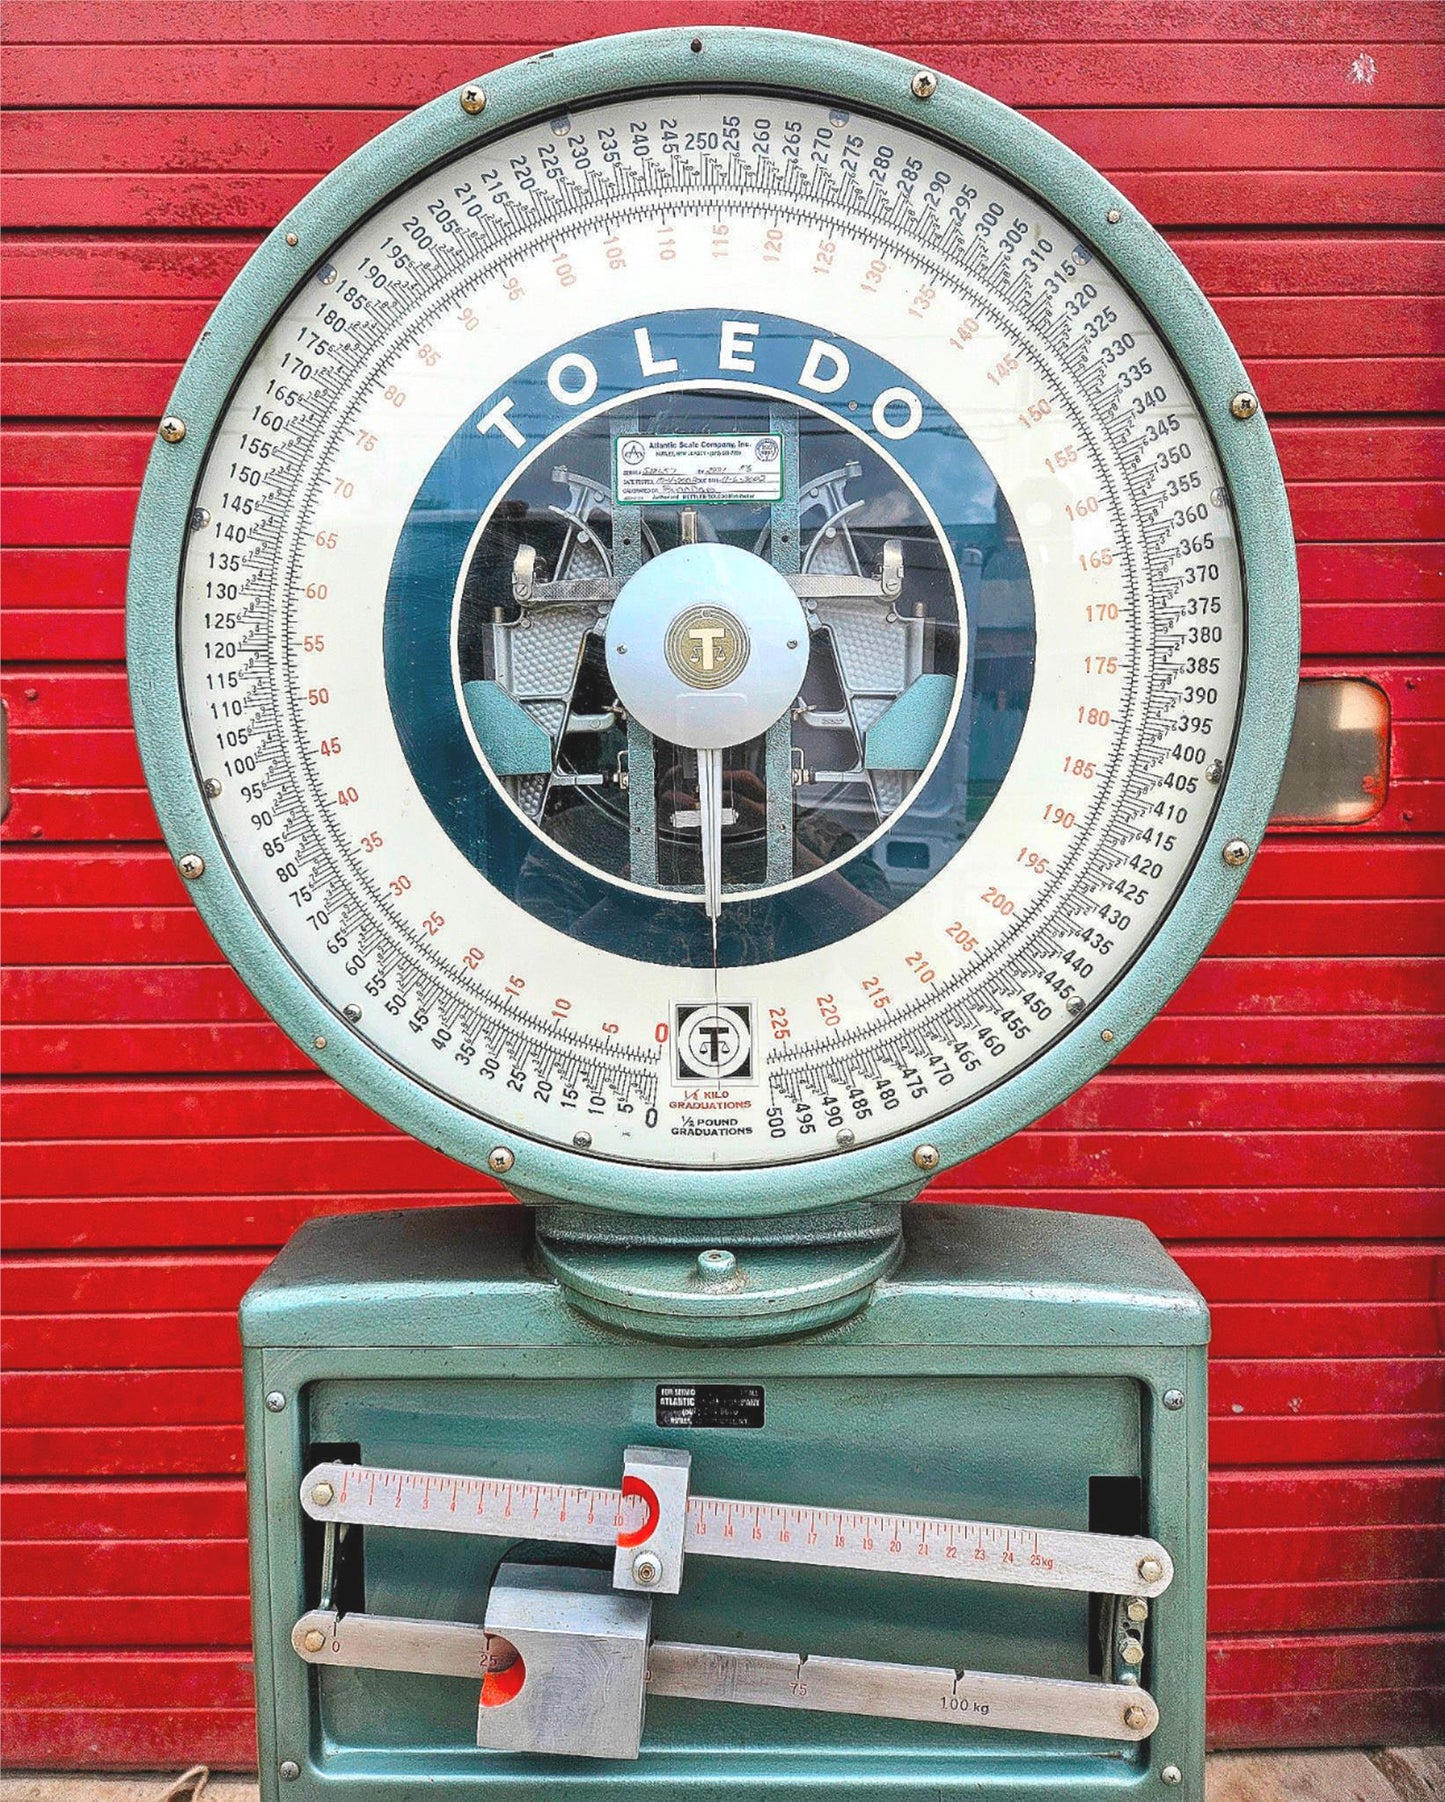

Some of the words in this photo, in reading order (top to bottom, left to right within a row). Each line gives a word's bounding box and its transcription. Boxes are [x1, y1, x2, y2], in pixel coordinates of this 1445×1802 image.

[598, 128, 621, 162] 235
[630, 122, 650, 156] 240
[684, 133, 718, 149] 250
[722, 116, 740, 151] 255
[752, 119, 771, 154] 260
[811, 128, 833, 164] 270
[568, 135, 591, 169] 230
[840, 135, 864, 172] 275
[869, 146, 894, 182] 280
[510, 155, 536, 190] 220
[481, 169, 510, 204] 215
[924, 171, 951, 207] 290
[454, 183, 482, 217] 210
[950, 184, 977, 222] 295
[402, 216, 432, 249] 200
[975, 203, 1004, 237] 300
[380, 237, 410, 269] 195
[763, 229, 783, 262] 120
[1022, 239, 1052, 273] 310
[358, 258, 387, 288] 190
[552, 253, 576, 287] 100
[860, 259, 887, 293] 130
[1044, 260, 1076, 294] 315
[1065, 284, 1097, 315] 320
[316, 303, 346, 332] 180
[297, 327, 329, 355] 175
[1101, 333, 1135, 363] 330
[281, 353, 312, 380] 170
[1118, 357, 1152, 388] 335
[476, 320, 923, 450] TOLEDO
[1132, 386, 1166, 414] 340
[252, 405, 283, 432] 160
[1018, 398, 1051, 428] 150
[240, 434, 272, 458] 155
[1157, 443, 1191, 469] 350
[1043, 446, 1076, 473] 155
[230, 463, 261, 486] 150
[1167, 471, 1201, 497] 355
[1065, 497, 1098, 522] 160
[1174, 503, 1208, 527] 360
[216, 522, 246, 543] 140
[209, 552, 240, 572] 135
[1079, 549, 1113, 573] 165
[1185, 564, 1219, 584] 370
[206, 581, 237, 600] 130
[304, 584, 329, 600] 60
[1086, 603, 1118, 620] 170
[1188, 597, 1221, 615] 375
[304, 634, 324, 652] 55
[1189, 626, 1222, 644] 380
[205, 642, 236, 659] 120
[1086, 656, 1117, 674] 175
[207, 671, 238, 690] 115
[308, 689, 329, 705] 50
[1184, 686, 1217, 704] 390
[211, 700, 242, 719] 110
[1078, 706, 1110, 727] 180
[1179, 715, 1213, 735] 395
[321, 738, 341, 756] 45
[1173, 744, 1206, 764] 400
[224, 756, 256, 777] 100
[1064, 756, 1095, 779] 185
[241, 782, 263, 803] 95
[338, 787, 358, 805] 40
[251, 811, 273, 830] 90
[1044, 804, 1075, 829] 190
[1154, 801, 1187, 824] 410
[361, 832, 383, 851] 35
[1142, 827, 1177, 851] 415
[276, 862, 298, 883] 80
[1018, 848, 1048, 874] 195
[1129, 854, 1163, 879] 420
[289, 886, 312, 907] 75
[390, 875, 411, 896] 30
[981, 886, 1015, 916] 200
[306, 911, 329, 931] 70
[423, 912, 446, 935] 25
[1099, 904, 1131, 931] 430
[946, 922, 977, 952] 205
[1081, 928, 1114, 955] 435
[345, 954, 366, 976] 60
[463, 947, 484, 970] 20
[906, 952, 935, 984] 210
[1062, 950, 1093, 978] 440
[364, 974, 386, 997] 55
[505, 977, 525, 995] 15
[862, 976, 890, 1008] 215
[384, 994, 406, 1015] 50
[552, 998, 571, 1018] 10
[816, 994, 840, 1026] 220
[1022, 992, 1052, 1021] 450
[602, 1022, 619, 1035] 5
[655, 1023, 669, 1043] 0
[769, 1009, 791, 1039] 225
[1001, 1010, 1031, 1039] 455
[431, 1028, 452, 1050] 40
[978, 1027, 1006, 1057] 460
[455, 1043, 476, 1065] 35
[479, 1058, 500, 1080] 30
[929, 1056, 954, 1086] 470
[533, 1081, 553, 1103] 20
[704, 1091, 729, 1099] KILO
[876, 1080, 900, 1110] 480
[903, 1068, 928, 1099] 475
[560, 1089, 578, 1108] 15
[588, 1097, 606, 1114] 10
[669, 1101, 752, 1109] GRADUATIONS
[645, 1108, 658, 1128] 0
[697, 1118, 738, 1126] POUND
[767, 1107, 786, 1138] 500
[795, 1104, 816, 1134] 495
[822, 1097, 844, 1127] 490
[671, 1127, 753, 1136] GRADUATIONS
[340, 1491, 347, 1503] 0
[368, 1493, 373, 1504] 1
[395, 1496, 402, 1508] 2
[423, 1497, 429, 1510] 3
[450, 1501, 457, 1512] 4
[477, 1503, 484, 1515] 5
[504, 1506, 511, 1518] 6
[533, 1506, 539, 1518] 7
[559, 1510, 567, 1522] 8
[587, 1513, 595, 1525] 9
[613, 1515, 625, 1528] 10
[697, 1523, 706, 1535] 13
[723, 1524, 735, 1538] 14
[752, 1528, 762, 1541] 15
[779, 1530, 790, 1543] 16
[807, 1531, 817, 1544] 17
[835, 1534, 845, 1548] 18
[863, 1538, 873, 1551] 19
[889, 1539, 901, 1553] 20
[918, 1544, 928, 1556] 21
[946, 1545, 957, 1559] 22
[973, 1547, 986, 1561] 23
[1003, 1550, 1014, 1563] 24
[332, 1640, 341, 1653] 0
[480, 1653, 497, 1668] 25
[790, 1682, 808, 1696] 75
[941, 1696, 969, 1711] 100
[973, 1702, 989, 1715] kg
